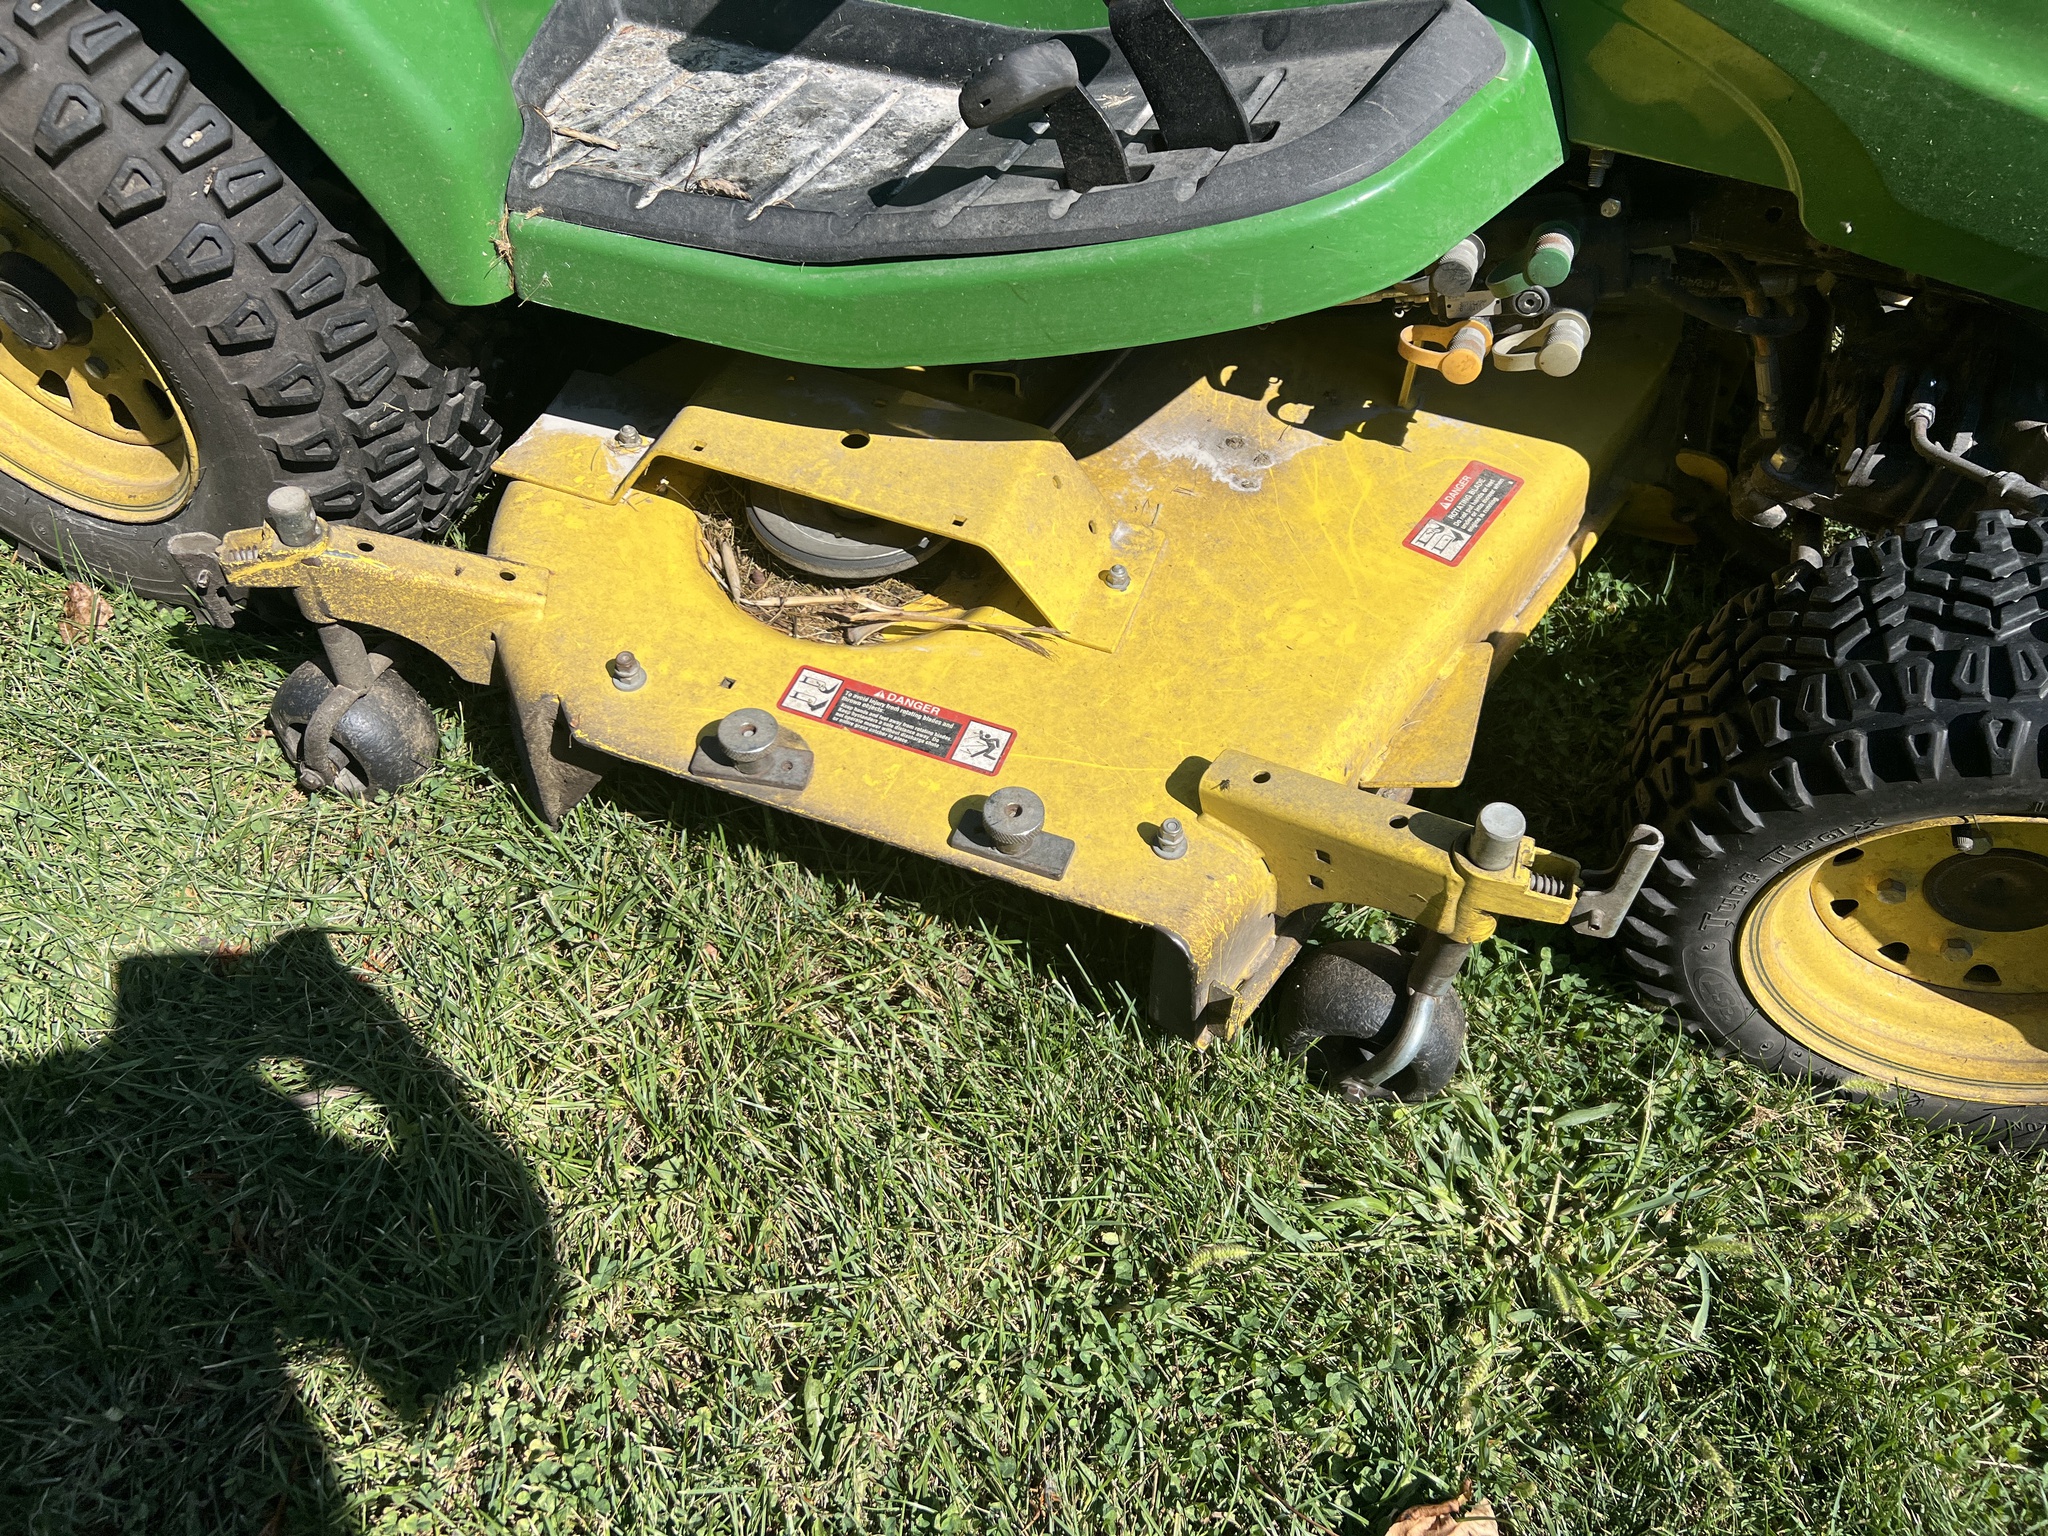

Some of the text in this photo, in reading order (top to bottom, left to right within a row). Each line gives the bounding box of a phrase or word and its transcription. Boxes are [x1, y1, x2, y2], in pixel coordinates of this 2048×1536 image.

[1444, 474, 1471, 502] DANGER
[1447, 476, 1486, 519] ROTATING BLADE
[841, 695, 862, 705] thrown
[852, 693, 869, 702] avoid
[868, 698, 886, 708] injury
[885, 703, 900, 712] from
[898, 707, 923, 719] rotating
[921, 714, 942, 725] blades
[941, 720, 954, 728] and
[886, 692, 941, 716] DANGER
